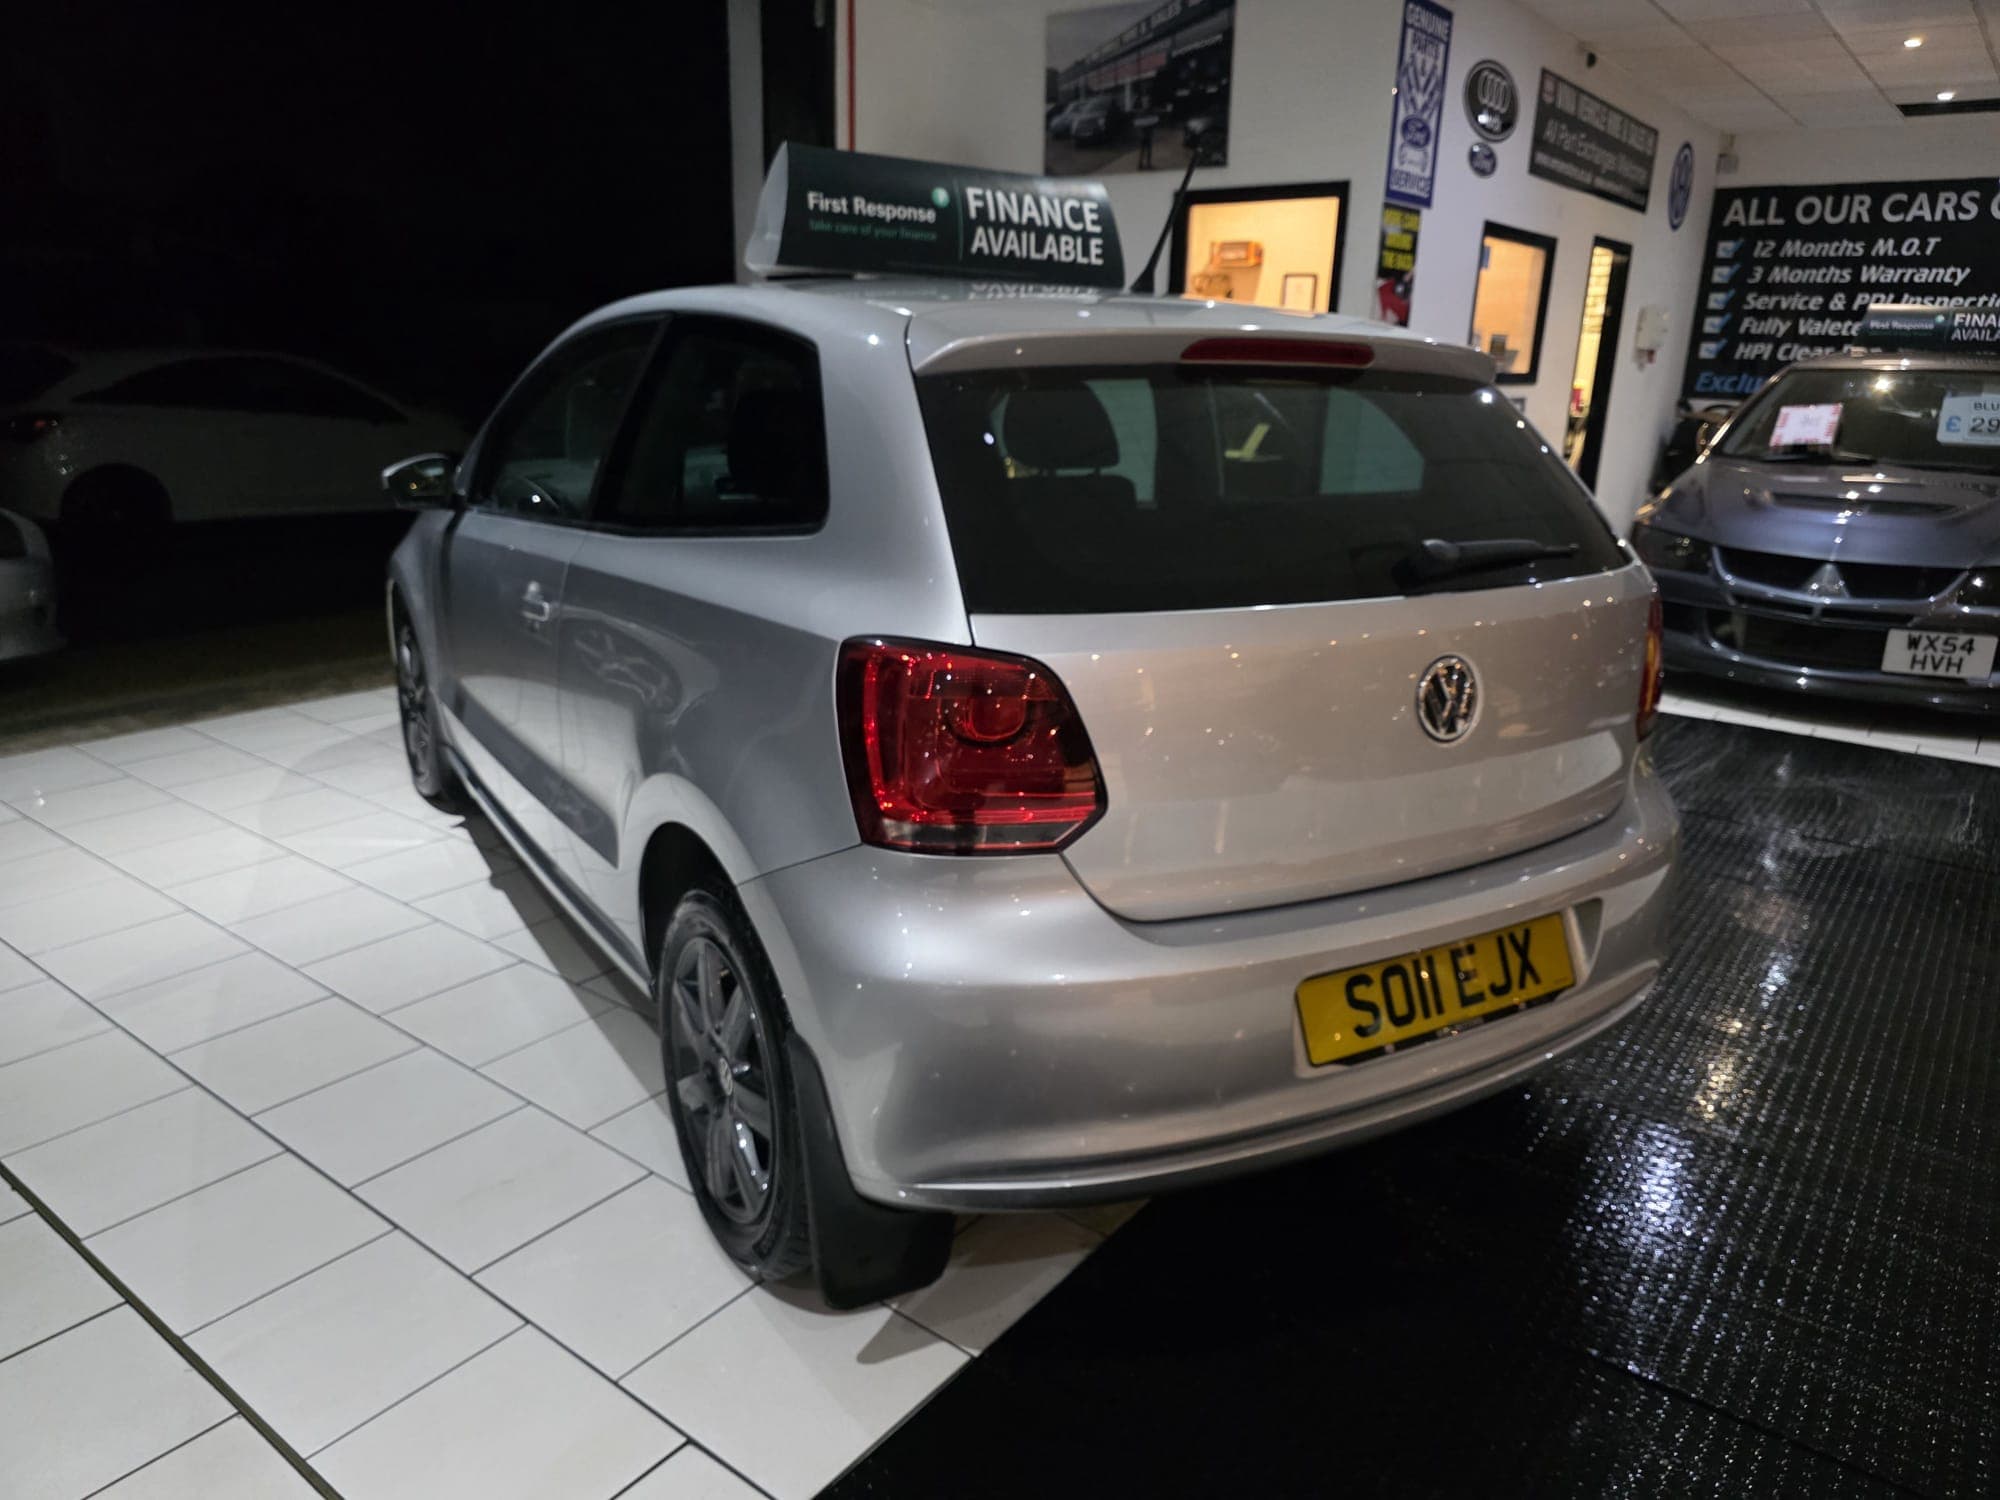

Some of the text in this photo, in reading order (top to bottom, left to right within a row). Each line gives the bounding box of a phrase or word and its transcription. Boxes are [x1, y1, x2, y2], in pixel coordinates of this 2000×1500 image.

[1405, 1, 1450, 41] GENUINE
[1390, 169, 1431, 197] SERVICE
[807, 190, 936, 223] First Response
[966, 187, 1102, 233] FINANCE
[1723, 198, 1785, 226] ALL
[1795, 195, 1872, 224] OUR
[1881, 191, 1980, 223] CARS
[971, 227, 1104, 265] AVAILABLE
[1753, 237, 1942, 258] 12 Months M.O.T
[1749, 265, 1971, 287] 3 Months Warranty
[1742, 292, 1825, 310] Service
[1828, 293, 1847, 311] &
[1738, 317, 1792, 338] Fully
[1954, 313, 2000, 328] FINA
[1733, 342, 1775, 360] HPI
[1907, 632, 1975, 656] WX54
[1910, 653, 1964, 675] HVH
[1345, 928, 1542, 1038] SO11 EJX
